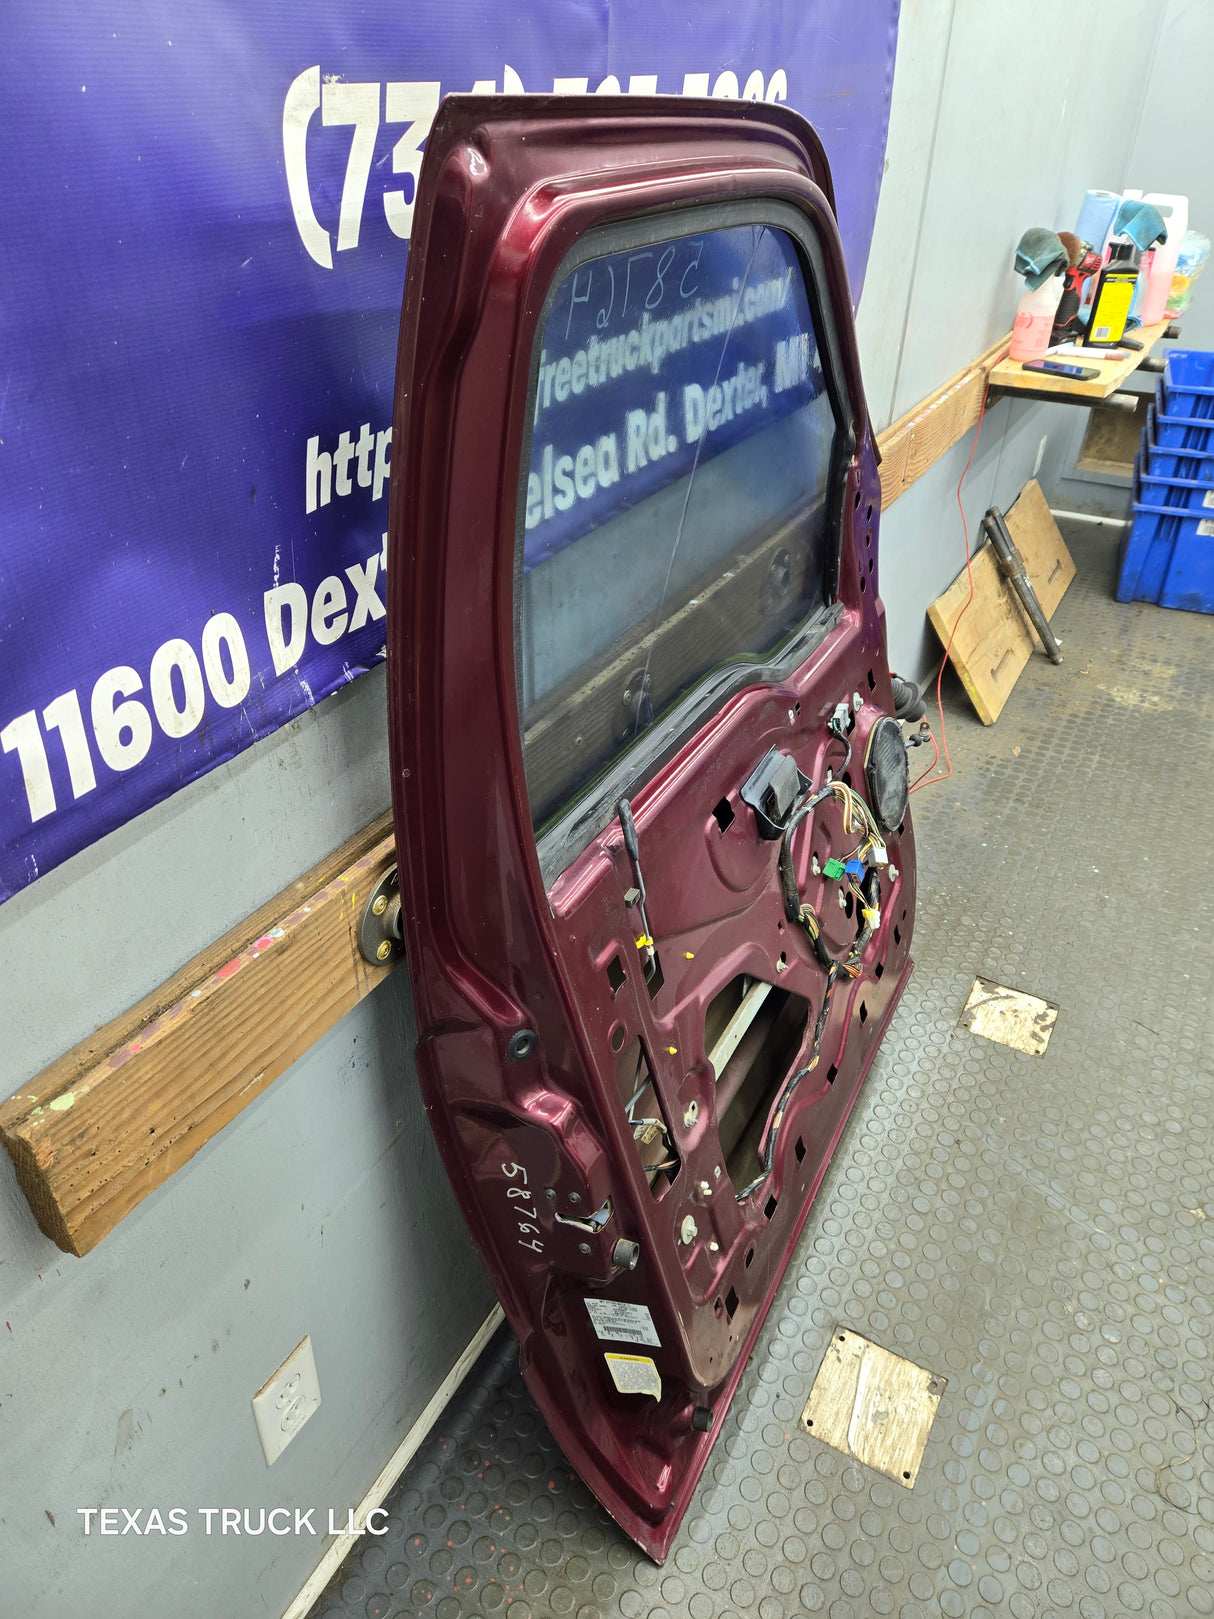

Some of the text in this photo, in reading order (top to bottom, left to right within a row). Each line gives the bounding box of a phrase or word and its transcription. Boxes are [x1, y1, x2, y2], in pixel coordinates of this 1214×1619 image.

[0, 612, 252, 824] 11600
[263, 531, 388, 678] Dex
[625, 390, 680, 475] Rd.
[501, 1162, 544, 1253] 58764
